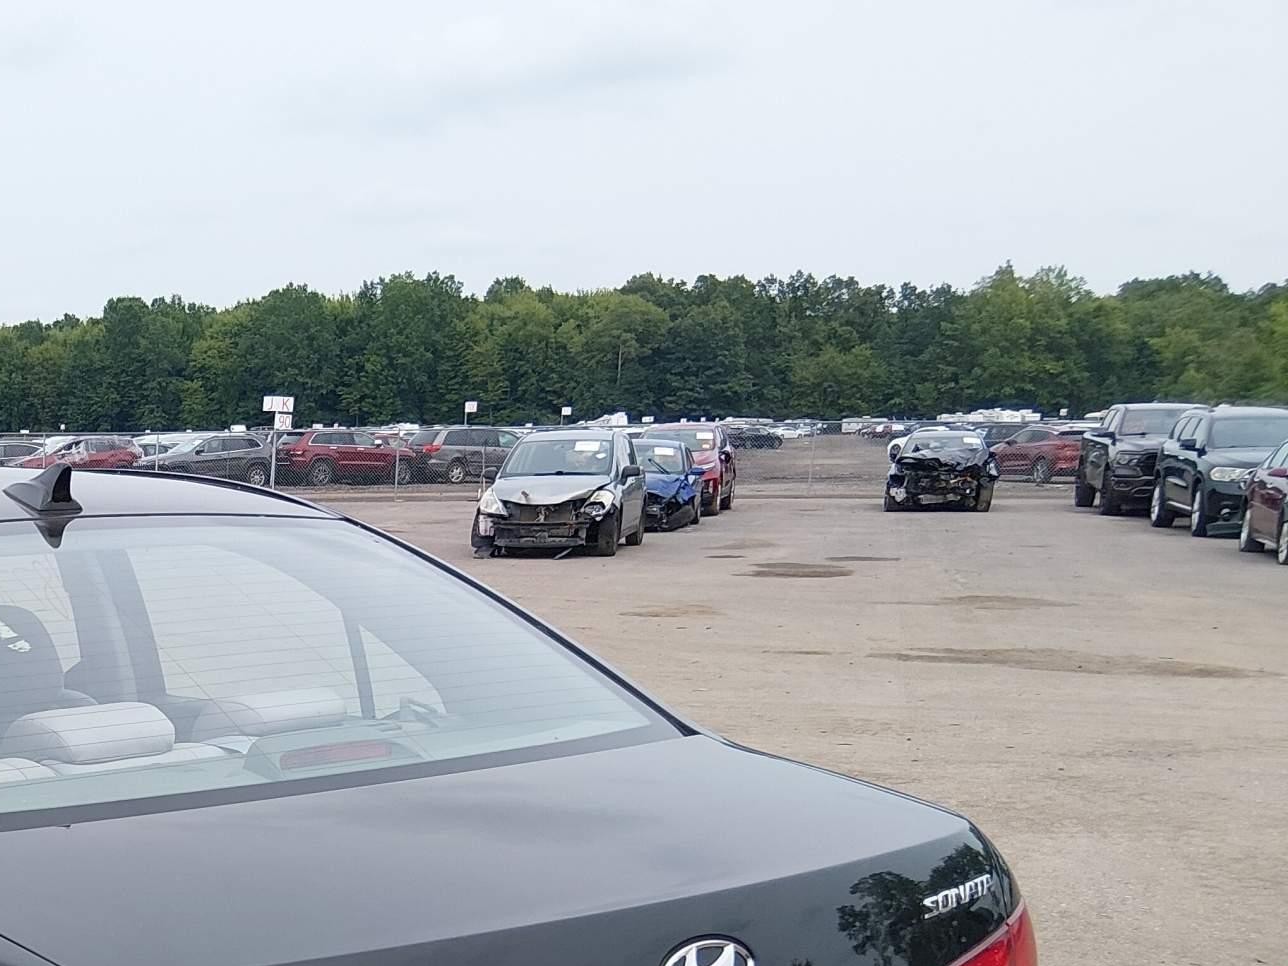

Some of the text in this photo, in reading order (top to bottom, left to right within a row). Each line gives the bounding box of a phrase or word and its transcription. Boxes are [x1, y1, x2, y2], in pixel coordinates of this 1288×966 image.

[267, 397, 290, 411] J K
[278, 415, 291, 429] 90
[921, 873, 995, 920] SONATA
